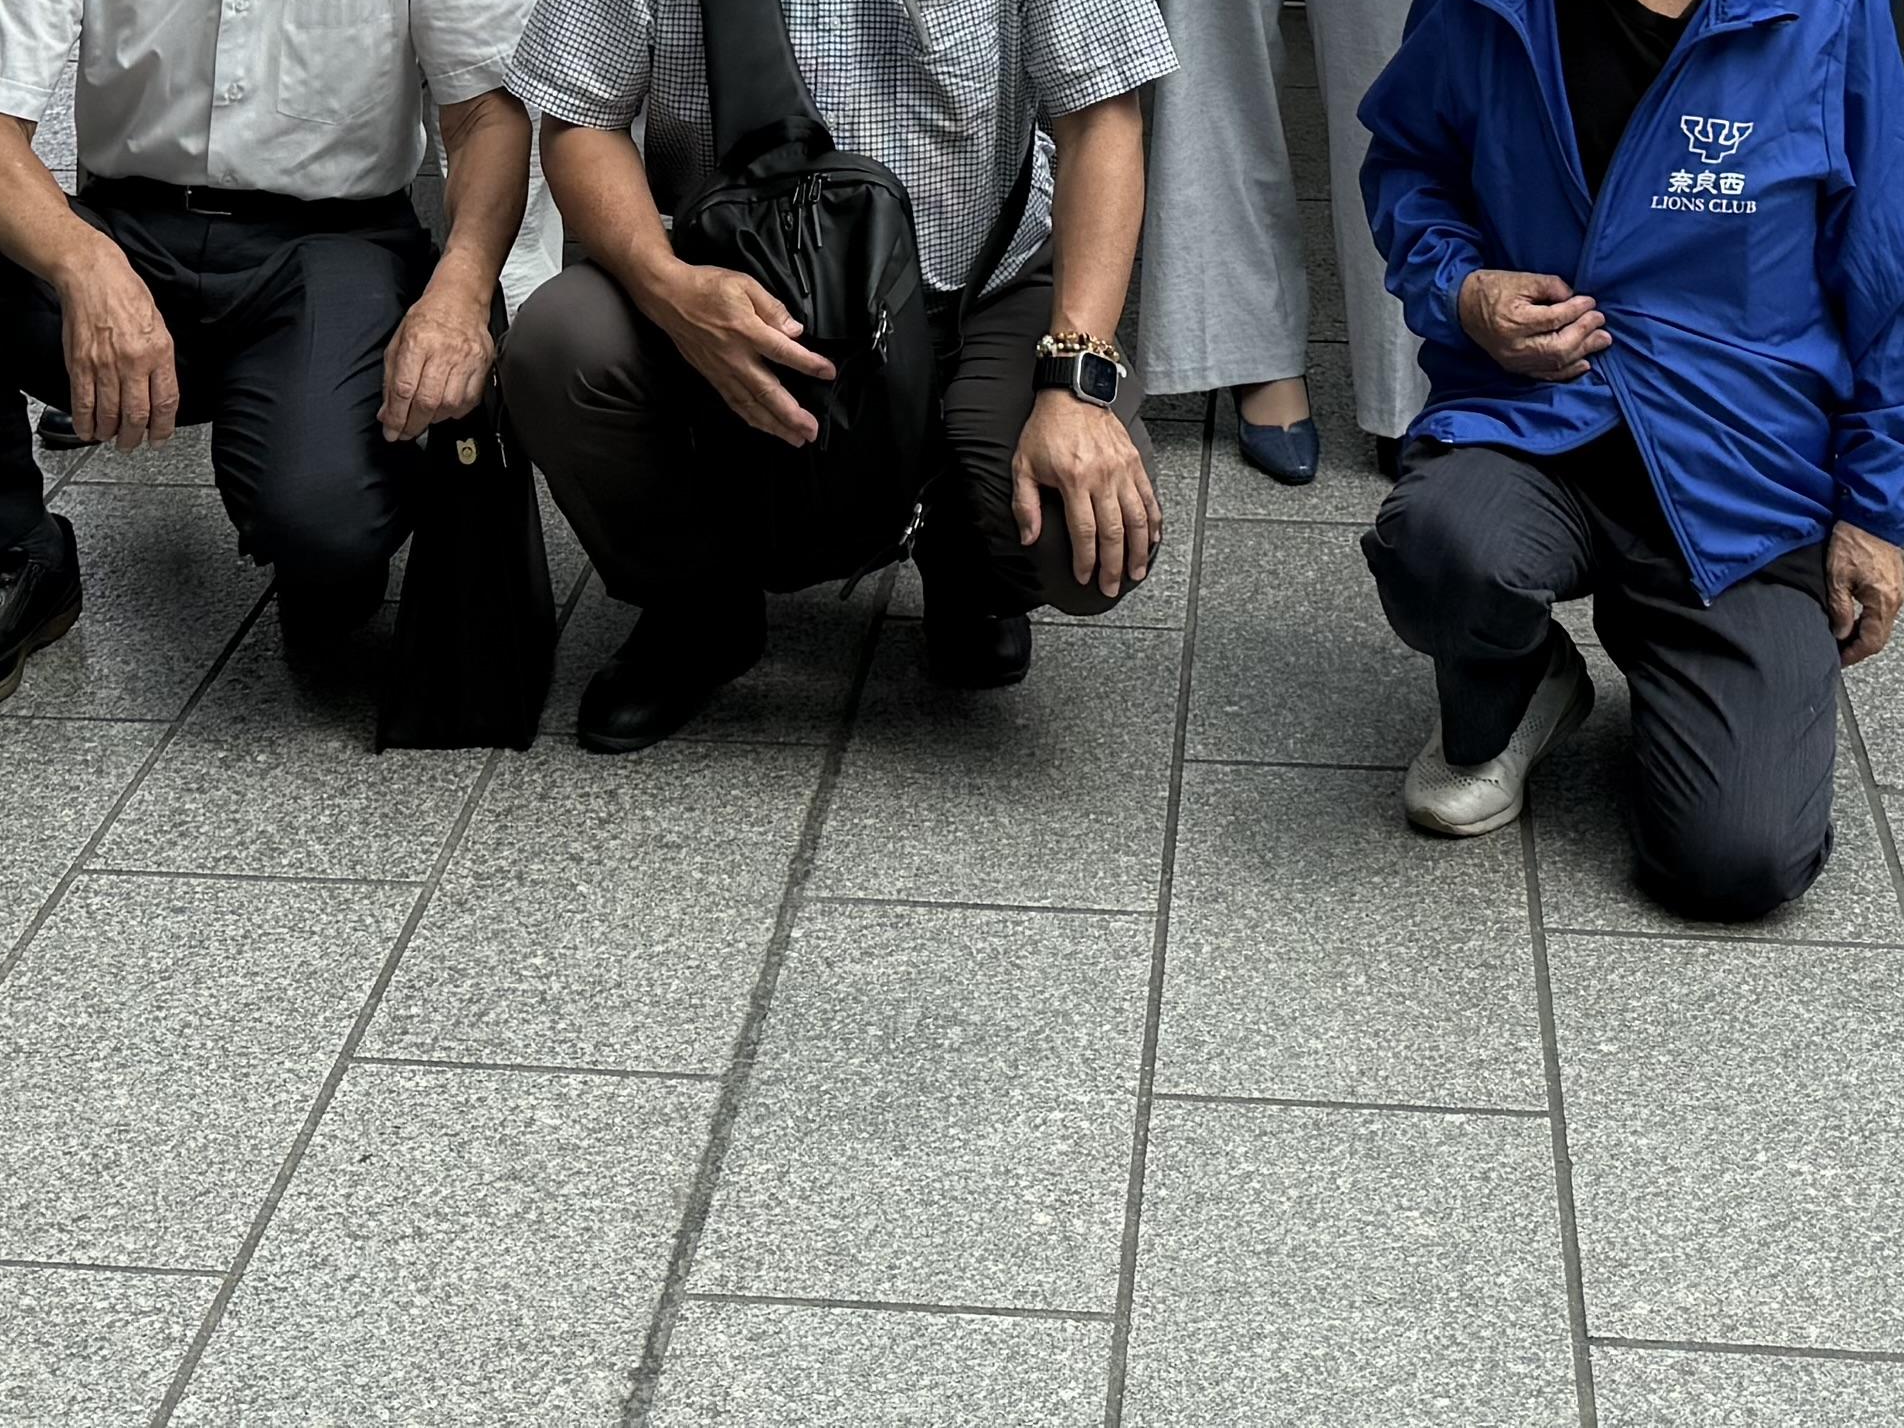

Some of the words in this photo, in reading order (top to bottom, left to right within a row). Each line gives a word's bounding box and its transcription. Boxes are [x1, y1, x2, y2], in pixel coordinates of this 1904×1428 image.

[1667, 168, 1746, 196] 奈良西
[1650, 194, 1705, 213] LIONS
[1708, 198, 1758, 215] CLUB
